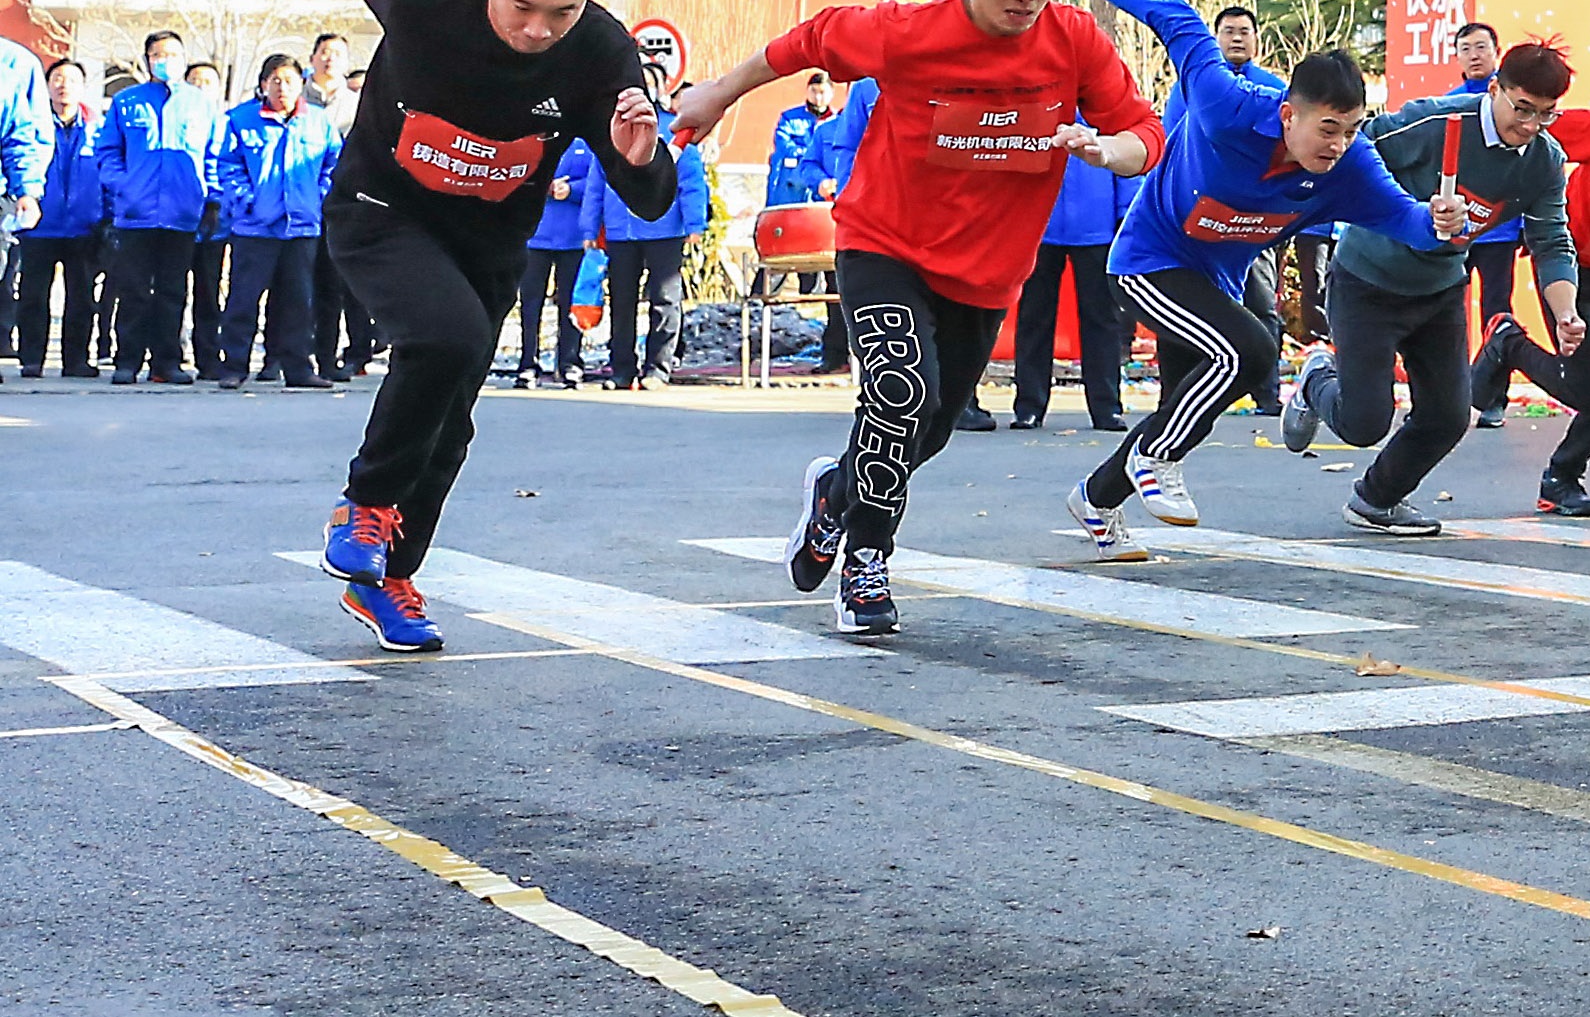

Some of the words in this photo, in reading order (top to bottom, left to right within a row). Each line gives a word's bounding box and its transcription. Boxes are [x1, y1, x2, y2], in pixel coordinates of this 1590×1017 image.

[978, 111, 1019, 126] JIER
[451, 135, 497, 159] JIER
[936, 134, 1051, 152] 新光机电有限公司
[412, 142, 528, 181] 铸造有限公司
[1229, 215, 1264, 224] JIER
[853, 303, 926, 517] PROJECT
